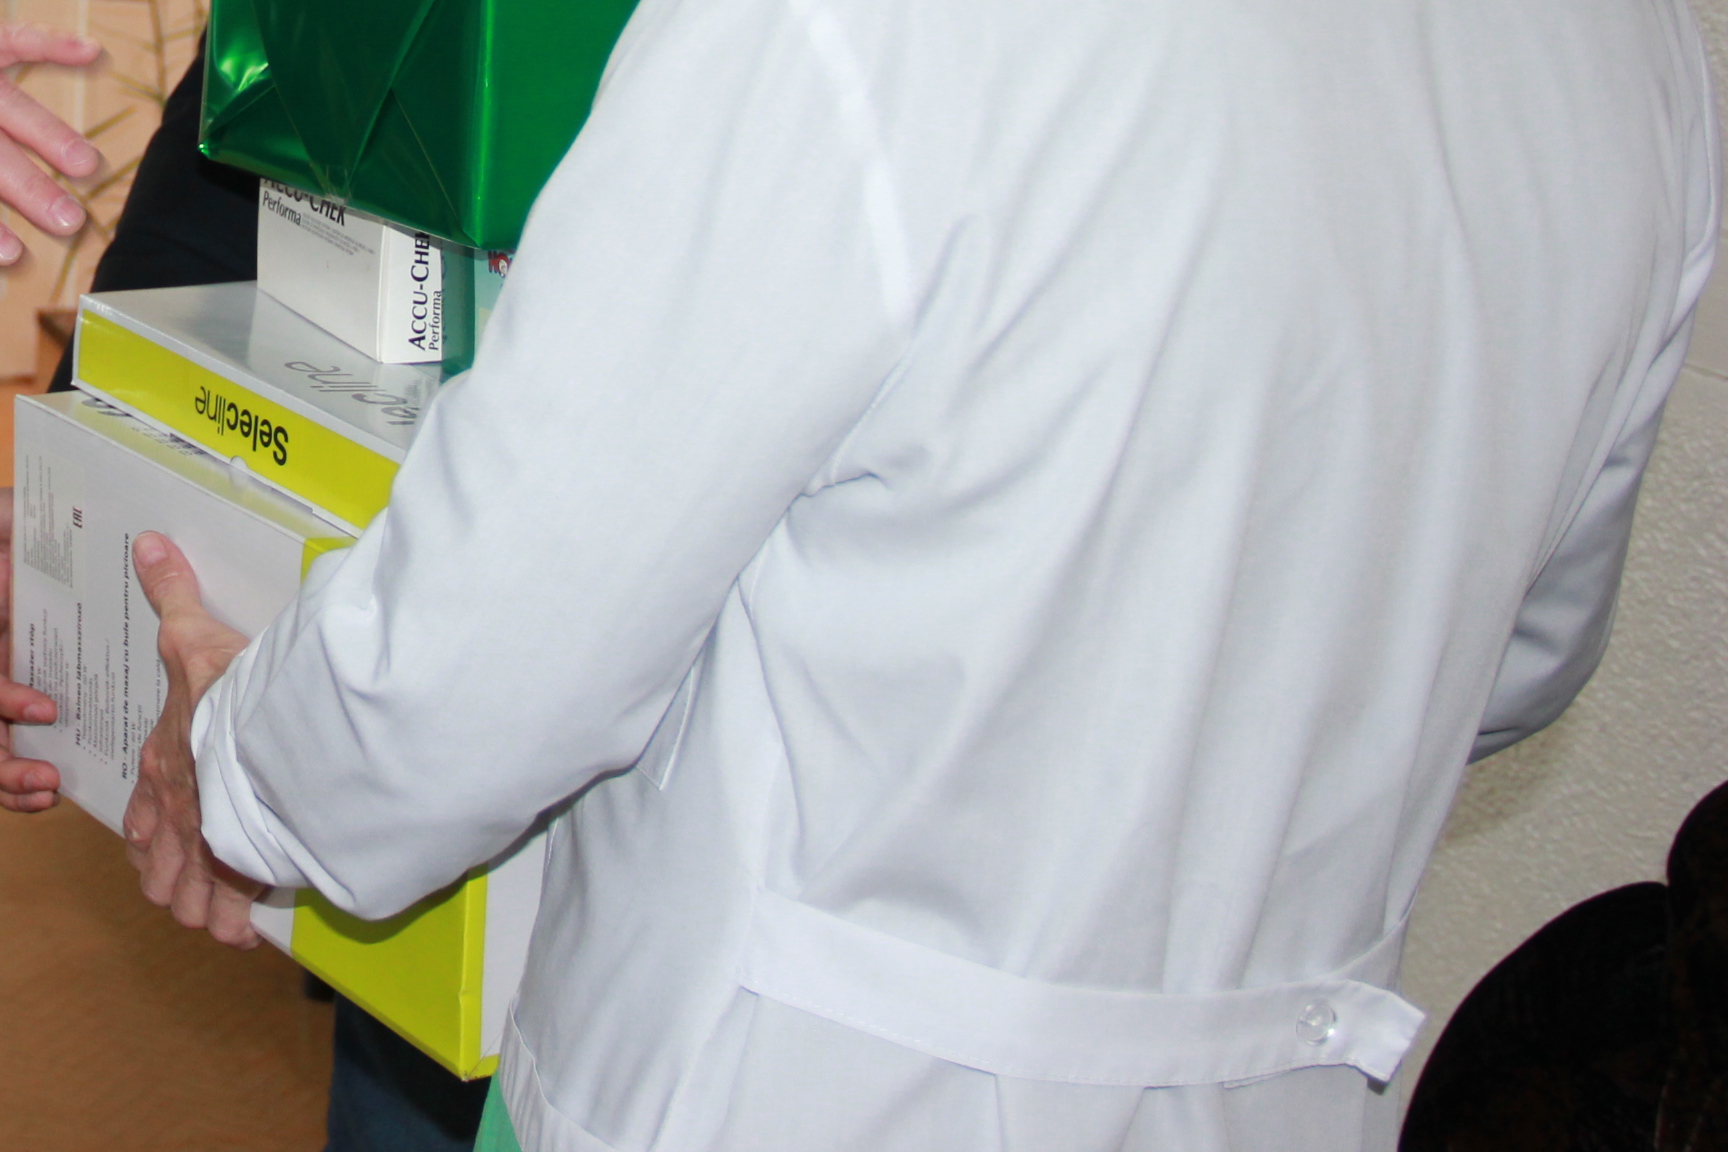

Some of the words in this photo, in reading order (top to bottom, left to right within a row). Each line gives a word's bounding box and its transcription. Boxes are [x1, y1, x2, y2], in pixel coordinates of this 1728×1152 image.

[262, 190, 302, 226] Performa
[263, 178, 345, 226] U-CHEK
[408, 232, 430, 352] ACCU-CHE
[429, 290, 442, 350] Performa
[193, 383, 290, 467] Selecline
[122, 533, 130, 579] picioare
[124, 649, 128, 662] cu
[123, 700, 128, 713] de
[75, 728, 81, 746] HU
[122, 763, 127, 779] RO
